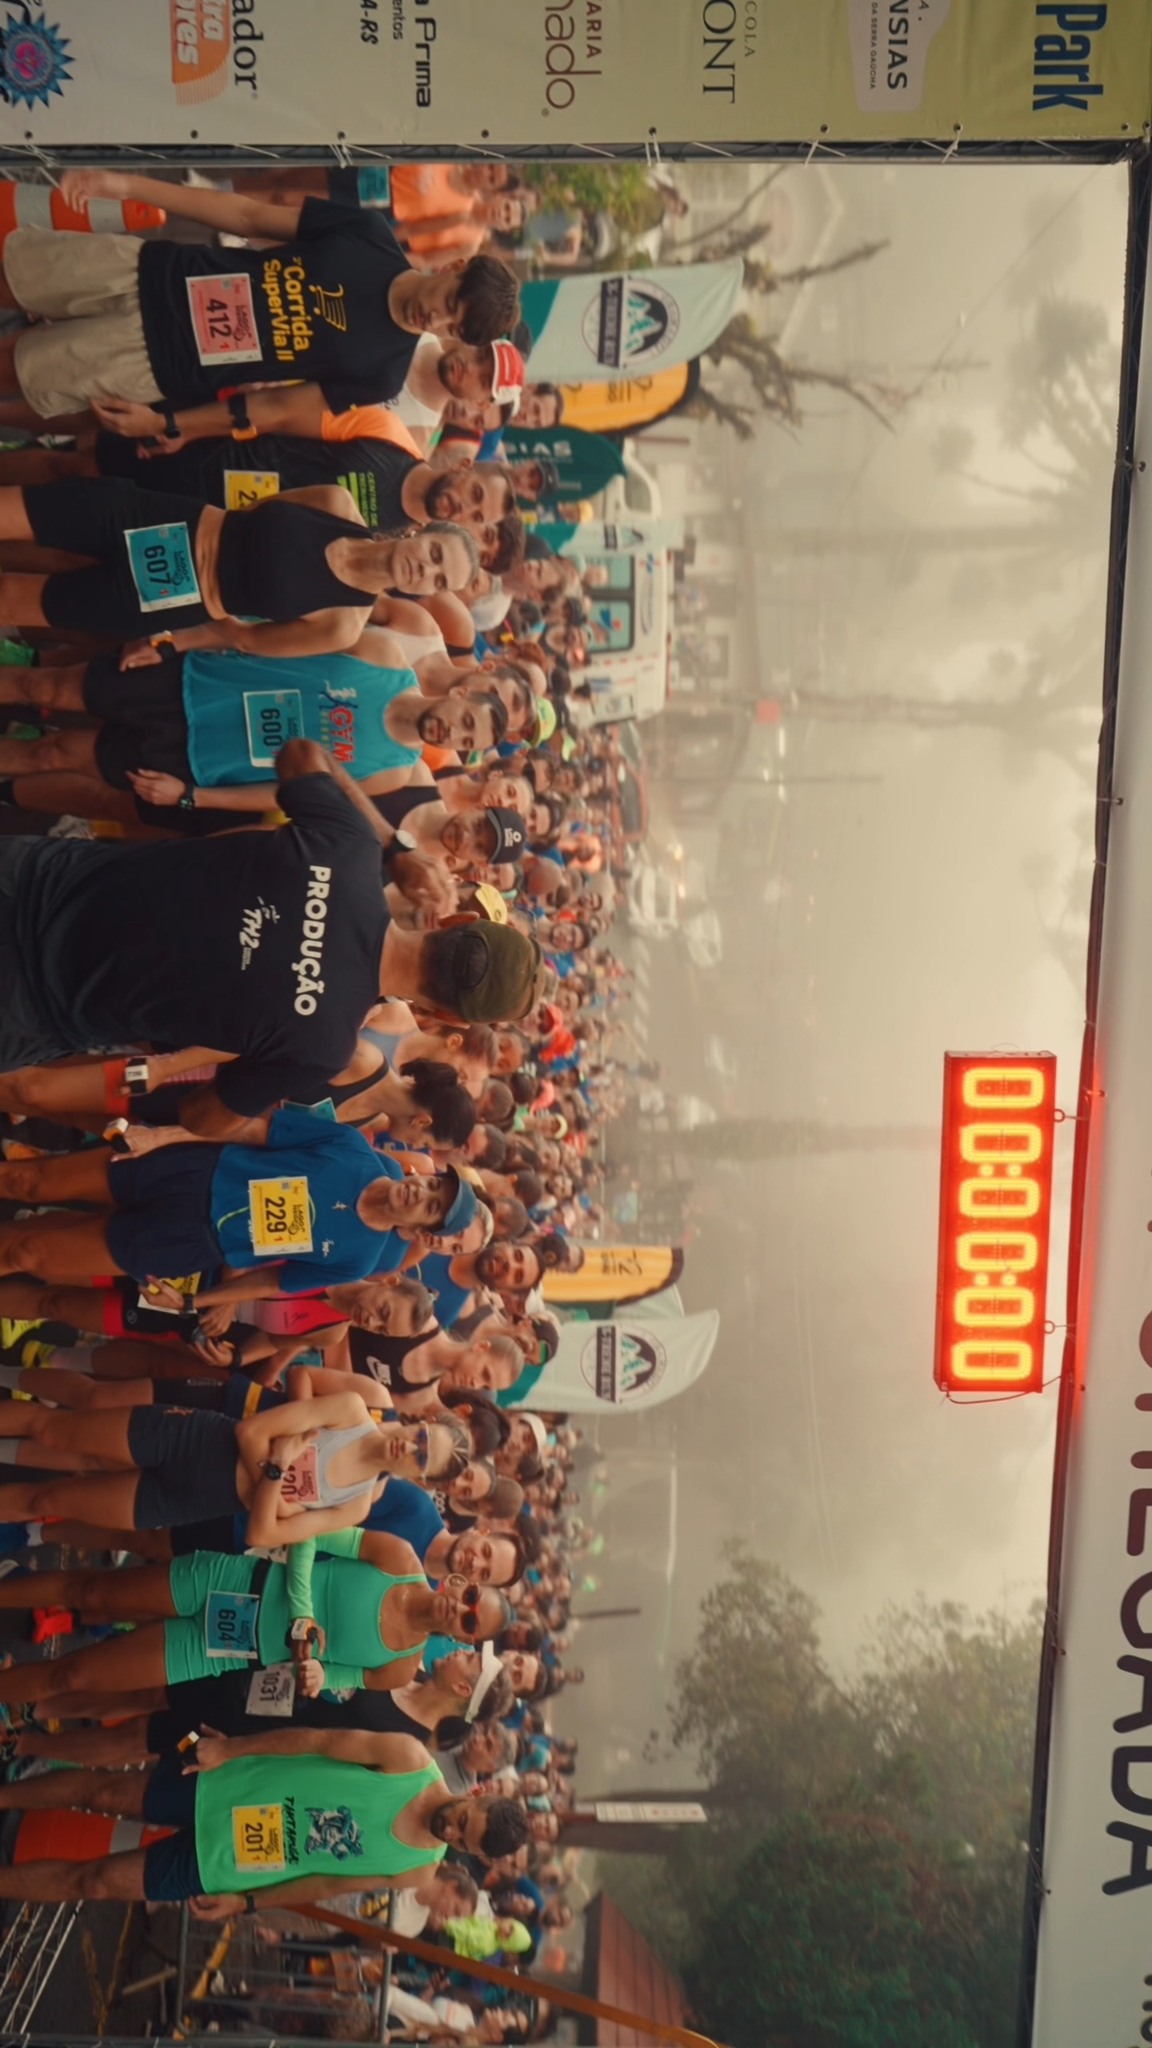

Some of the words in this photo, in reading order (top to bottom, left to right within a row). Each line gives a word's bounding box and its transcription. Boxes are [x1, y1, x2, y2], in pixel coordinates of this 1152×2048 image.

[586, 0, 602, 59] ARIA
[870, 18, 878, 47] SERRA
[415, 17, 437, 108] Prima
[703, 0, 736, 104] ONT
[1032, 4, 1107, 111] Park
[206, 299, 232, 338] 412
[262, 259, 291, 347] SuperVia
[284, 266, 313, 351] Corrida
[276, 350, 294, 361] II
[144, 545, 172, 584] 607
[260, 708, 283, 747] 600
[329, 706, 355, 763] GYM
[239, 908, 263, 949] TH2
[291, 865, 332, 1016] PRODUÇÃO
[265, 1196, 288, 1234] 229
[951, 1067, 1046, 1381] 00:00:00
[217, 1608, 237, 1642] 604
[259, 1671, 280, 1701] 1031
[245, 1822, 264, 1853] 201
